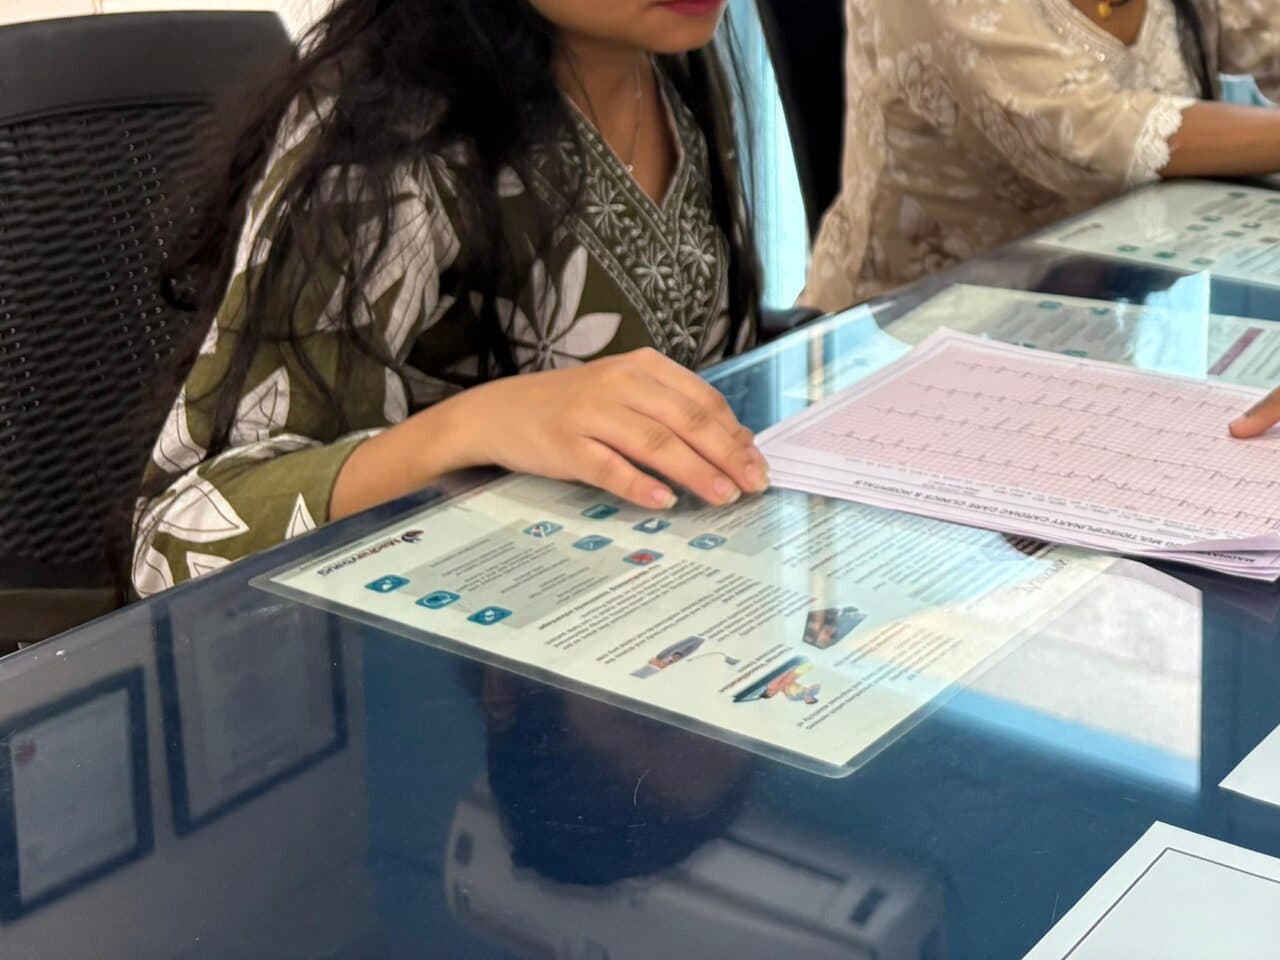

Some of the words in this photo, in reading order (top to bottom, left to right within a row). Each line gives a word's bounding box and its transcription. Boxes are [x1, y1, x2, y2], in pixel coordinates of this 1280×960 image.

[853, 479, 912, 496] HOSPITALS
[924, 493, 966, 506] CLINICS
[999, 508, 1049, 522] CARDIAC
